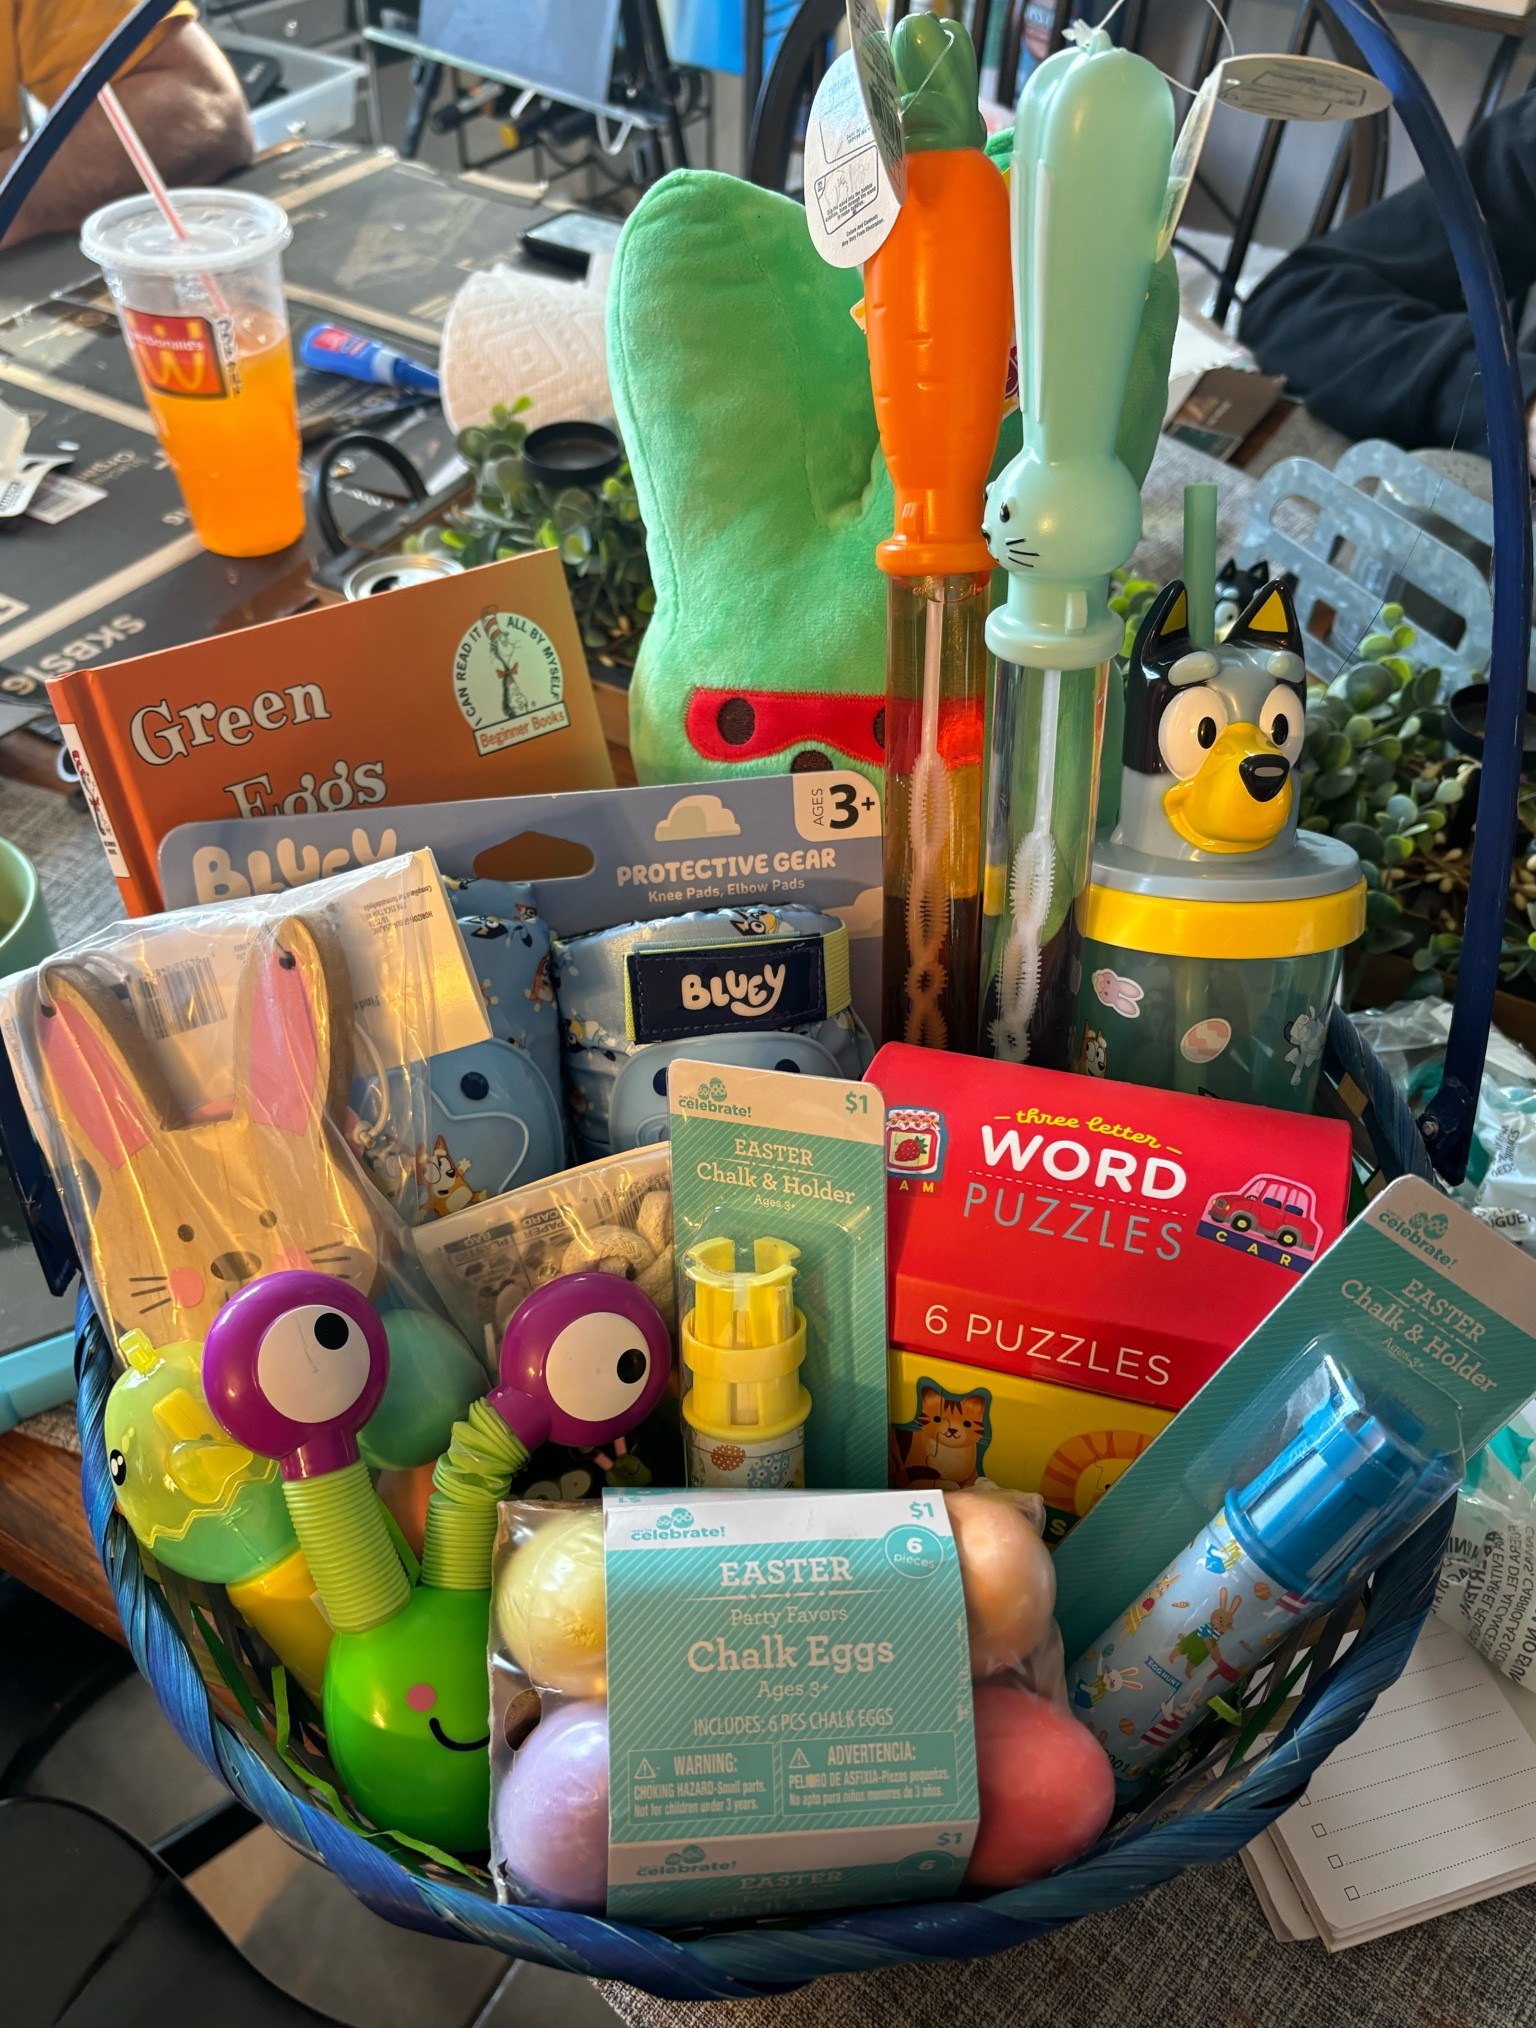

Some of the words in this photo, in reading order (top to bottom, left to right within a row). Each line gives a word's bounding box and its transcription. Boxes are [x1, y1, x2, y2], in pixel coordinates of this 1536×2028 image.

[469, 626, 482, 643] IT
[507, 616, 527, 633] ALL
[529, 627, 546, 645] BY
[456, 642, 472, 681] READ
[542, 645, 561, 700] MYSELF
[457, 687, 477, 717] CAN
[130, 682, 332, 767] Green
[479, 722, 530, 748] Beginner
[531, 710, 565, 731] Books
[812, 788, 824, 826] AGES
[829, 783, 876, 830] 3+
[617, 854, 769, 887] PROTECTIVE
[773, 848, 836, 872] GEAR
[648, 890, 683, 903] Knee
[686, 885, 724, 899] Pads,
[727, 881, 768, 896] Elbow
[772, 878, 805, 892] Pads
[678, 1098, 752, 1118] celebrate!
[845, 1091, 868, 1114] $1
[1015, 1108, 1080, 1129] three
[1085, 1116, 1162, 1150] letter
[734, 1138, 814, 1166] EASTER
[981, 1125, 1187, 1200] WORD
[697, 1162, 757, 1188] Chalk
[762, 1173, 777, 1191] &
[783, 1175, 856, 1205] Holder
[754, 1194, 781, 1209] Ages
[784, 1200, 796, 1211] 3+
[522, 1209, 558, 1226] CARD
[524, 1220, 565, 1240] PAPER
[963, 1182, 1183, 1261] PUZZLES
[1378, 1212, 1459, 1269] celebrate!
[1401, 1278, 1486, 1343] EASTER
[925, 1304, 949, 1335] 6
[966, 1313, 1172, 1386] PUZZLES
[1341, 1279, 1405, 1332] Chalk
[1403, 1323, 1424, 1345] &
[1423, 1335, 1498, 1393] Holder
[1381, 1337, 1410, 1362] Ages
[909, 1501, 934, 1519] $1
[630, 1526, 726, 1541] celebrate!
[906, 1537, 923, 1554] 6
[719, 1556, 853, 1587] EASTER
[894, 1554, 935, 1569] pieces
[731, 1609, 781, 1628] Party
[785, 1606, 848, 1623] Favors
[688, 1634, 798, 1673] Chalk
[806, 1635, 895, 1674] Eggs
[1148, 1660, 1163, 1675] EGG
[1161, 1671, 1180, 1688] HUNT
[757, 1680, 804, 1701] Ages
[809, 1681, 829, 1698] 3+
[694, 1716, 765, 1736] INCLUDES:
[768, 1715, 777, 1732] 6
[781, 1712, 805, 1731] PCS
[809, 1710, 856, 1729] CHALK
[858, 1708, 893, 1727] EGGS
[674, 1753, 737, 1776] WARNING:
[828, 1741, 916, 1766] ADVERTENCIA:
[634, 1783, 674, 1800] CHOKING
[743, 1780, 766, 1796] parts.
[830, 1772, 841, 1786] DE
[634, 1804, 648, 1817] Not
[651, 1803, 662, 1816] for
[665, 1802, 698, 1815] children
[701, 1800, 723, 1812] under
[734, 1798, 759, 1813] years.
[789, 1794, 800, 1806] No
[803, 1793, 821, 1807] apto
[823, 1793, 841, 1806] para
[904, 1786, 913, 1798] de
[937, 1832, 963, 1846] $1
[636, 1861, 737, 1878] celebrate!
[918, 1859, 936, 1871] 6
[740, 1871, 843, 1890] EASTER
